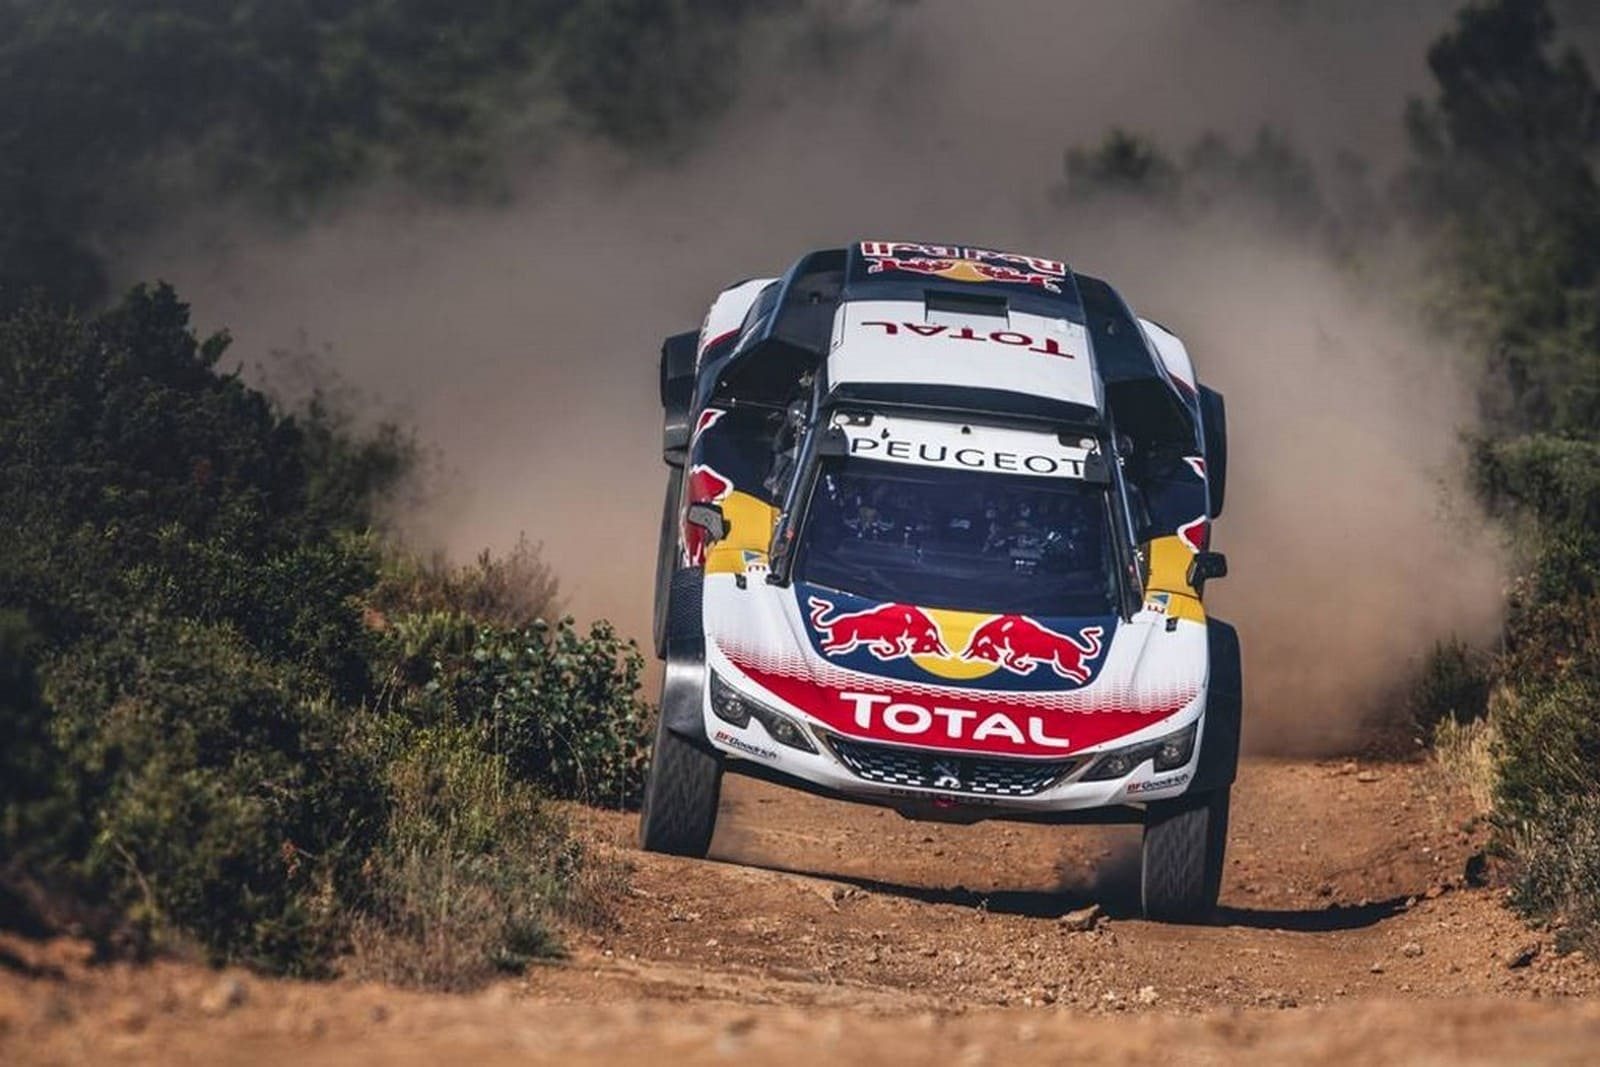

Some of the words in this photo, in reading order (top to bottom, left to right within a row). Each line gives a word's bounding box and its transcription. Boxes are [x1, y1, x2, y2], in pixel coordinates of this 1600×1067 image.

[861, 322, 1075, 359] TOTAL
[851, 438, 1085, 476] PEUGEOT
[839, 691, 1070, 748] TOTAL
[715, 730, 778, 760] BFGoodrich
